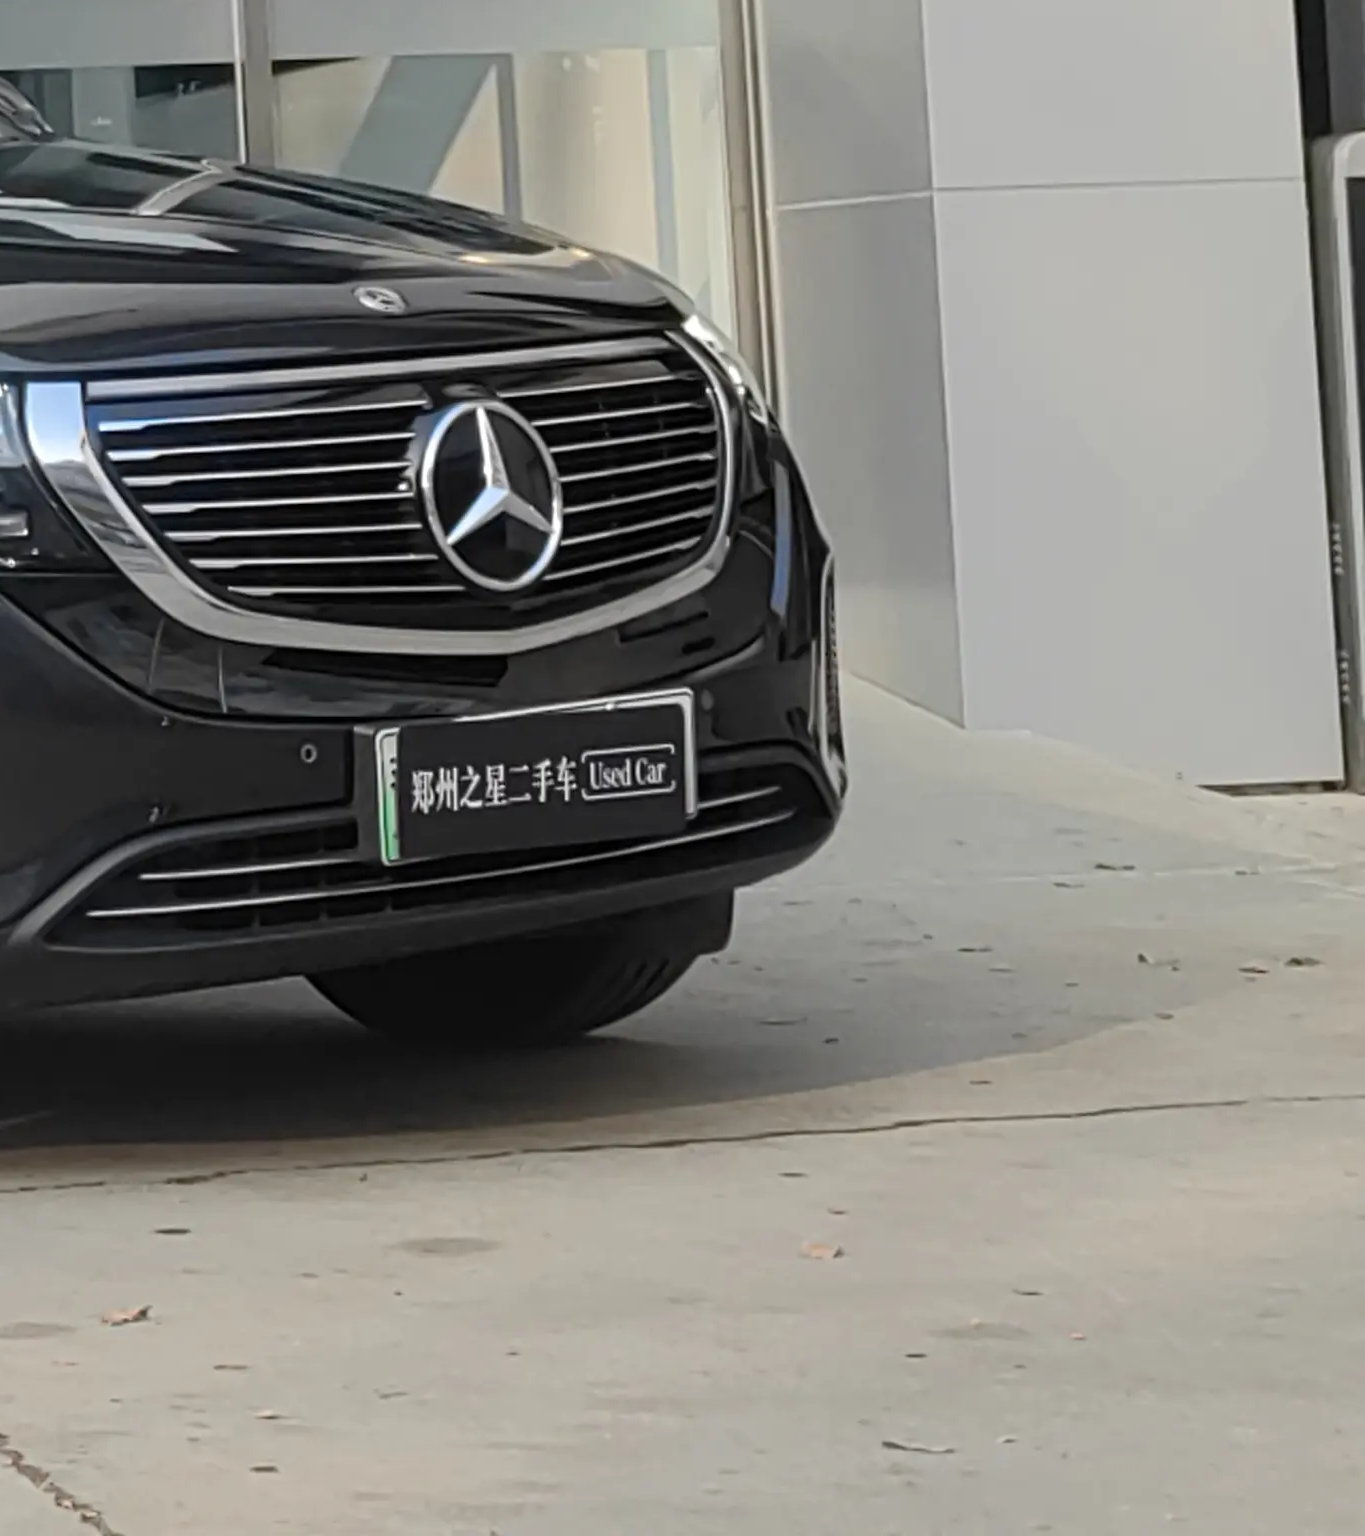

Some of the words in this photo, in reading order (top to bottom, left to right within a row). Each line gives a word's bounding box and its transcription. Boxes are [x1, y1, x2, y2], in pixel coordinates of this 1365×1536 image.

[410, 755, 578, 815] 郑州之星二手车
[589, 758, 631, 790] Used
[635, 757, 668, 785] Car
